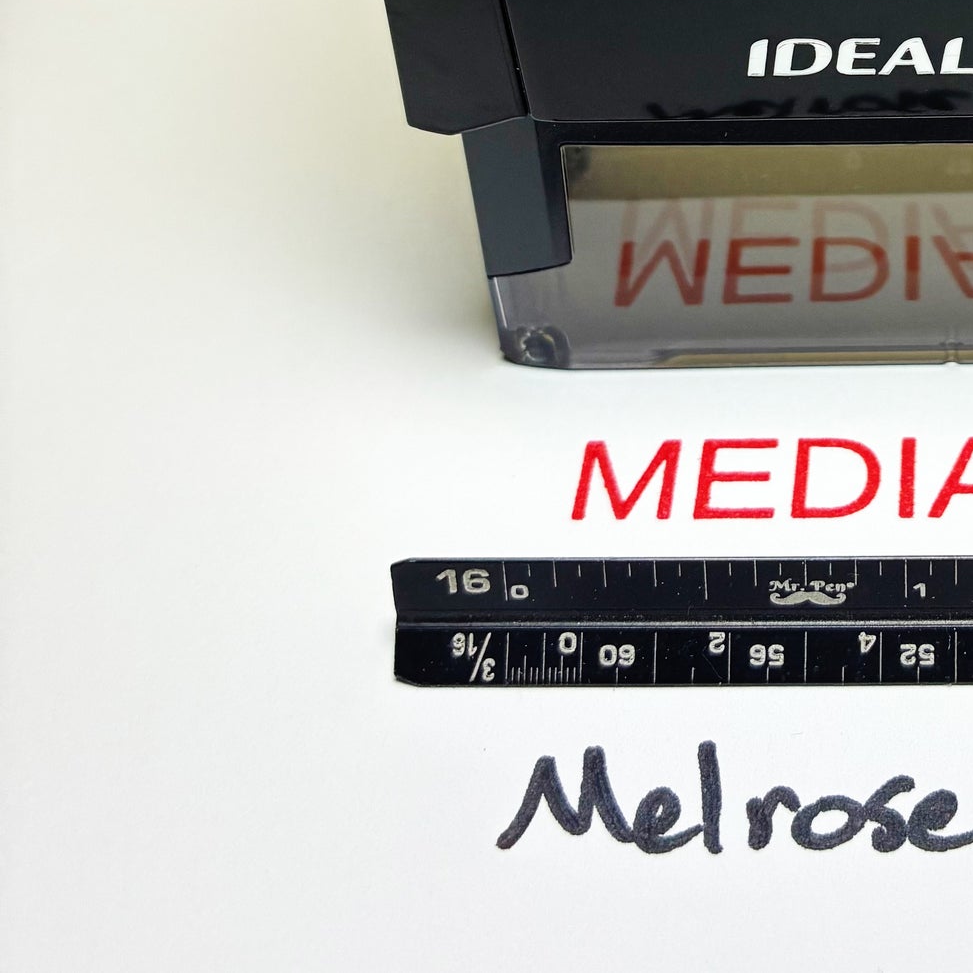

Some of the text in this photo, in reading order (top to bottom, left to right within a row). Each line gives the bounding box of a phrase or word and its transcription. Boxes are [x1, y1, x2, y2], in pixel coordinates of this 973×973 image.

[437, 569, 490, 593] 16
[511, 585, 528, 599] 0
[913, 583, 925, 597] 1
[769, 578, 805, 592] Mr.
[559, 632, 576, 658] 0
[709, 631, 726, 653] 2
[859, 632, 876, 653] 4
[599, 645, 635, 669] 60
[750, 644, 784, 666] 56
[900, 644, 934, 665] 52
